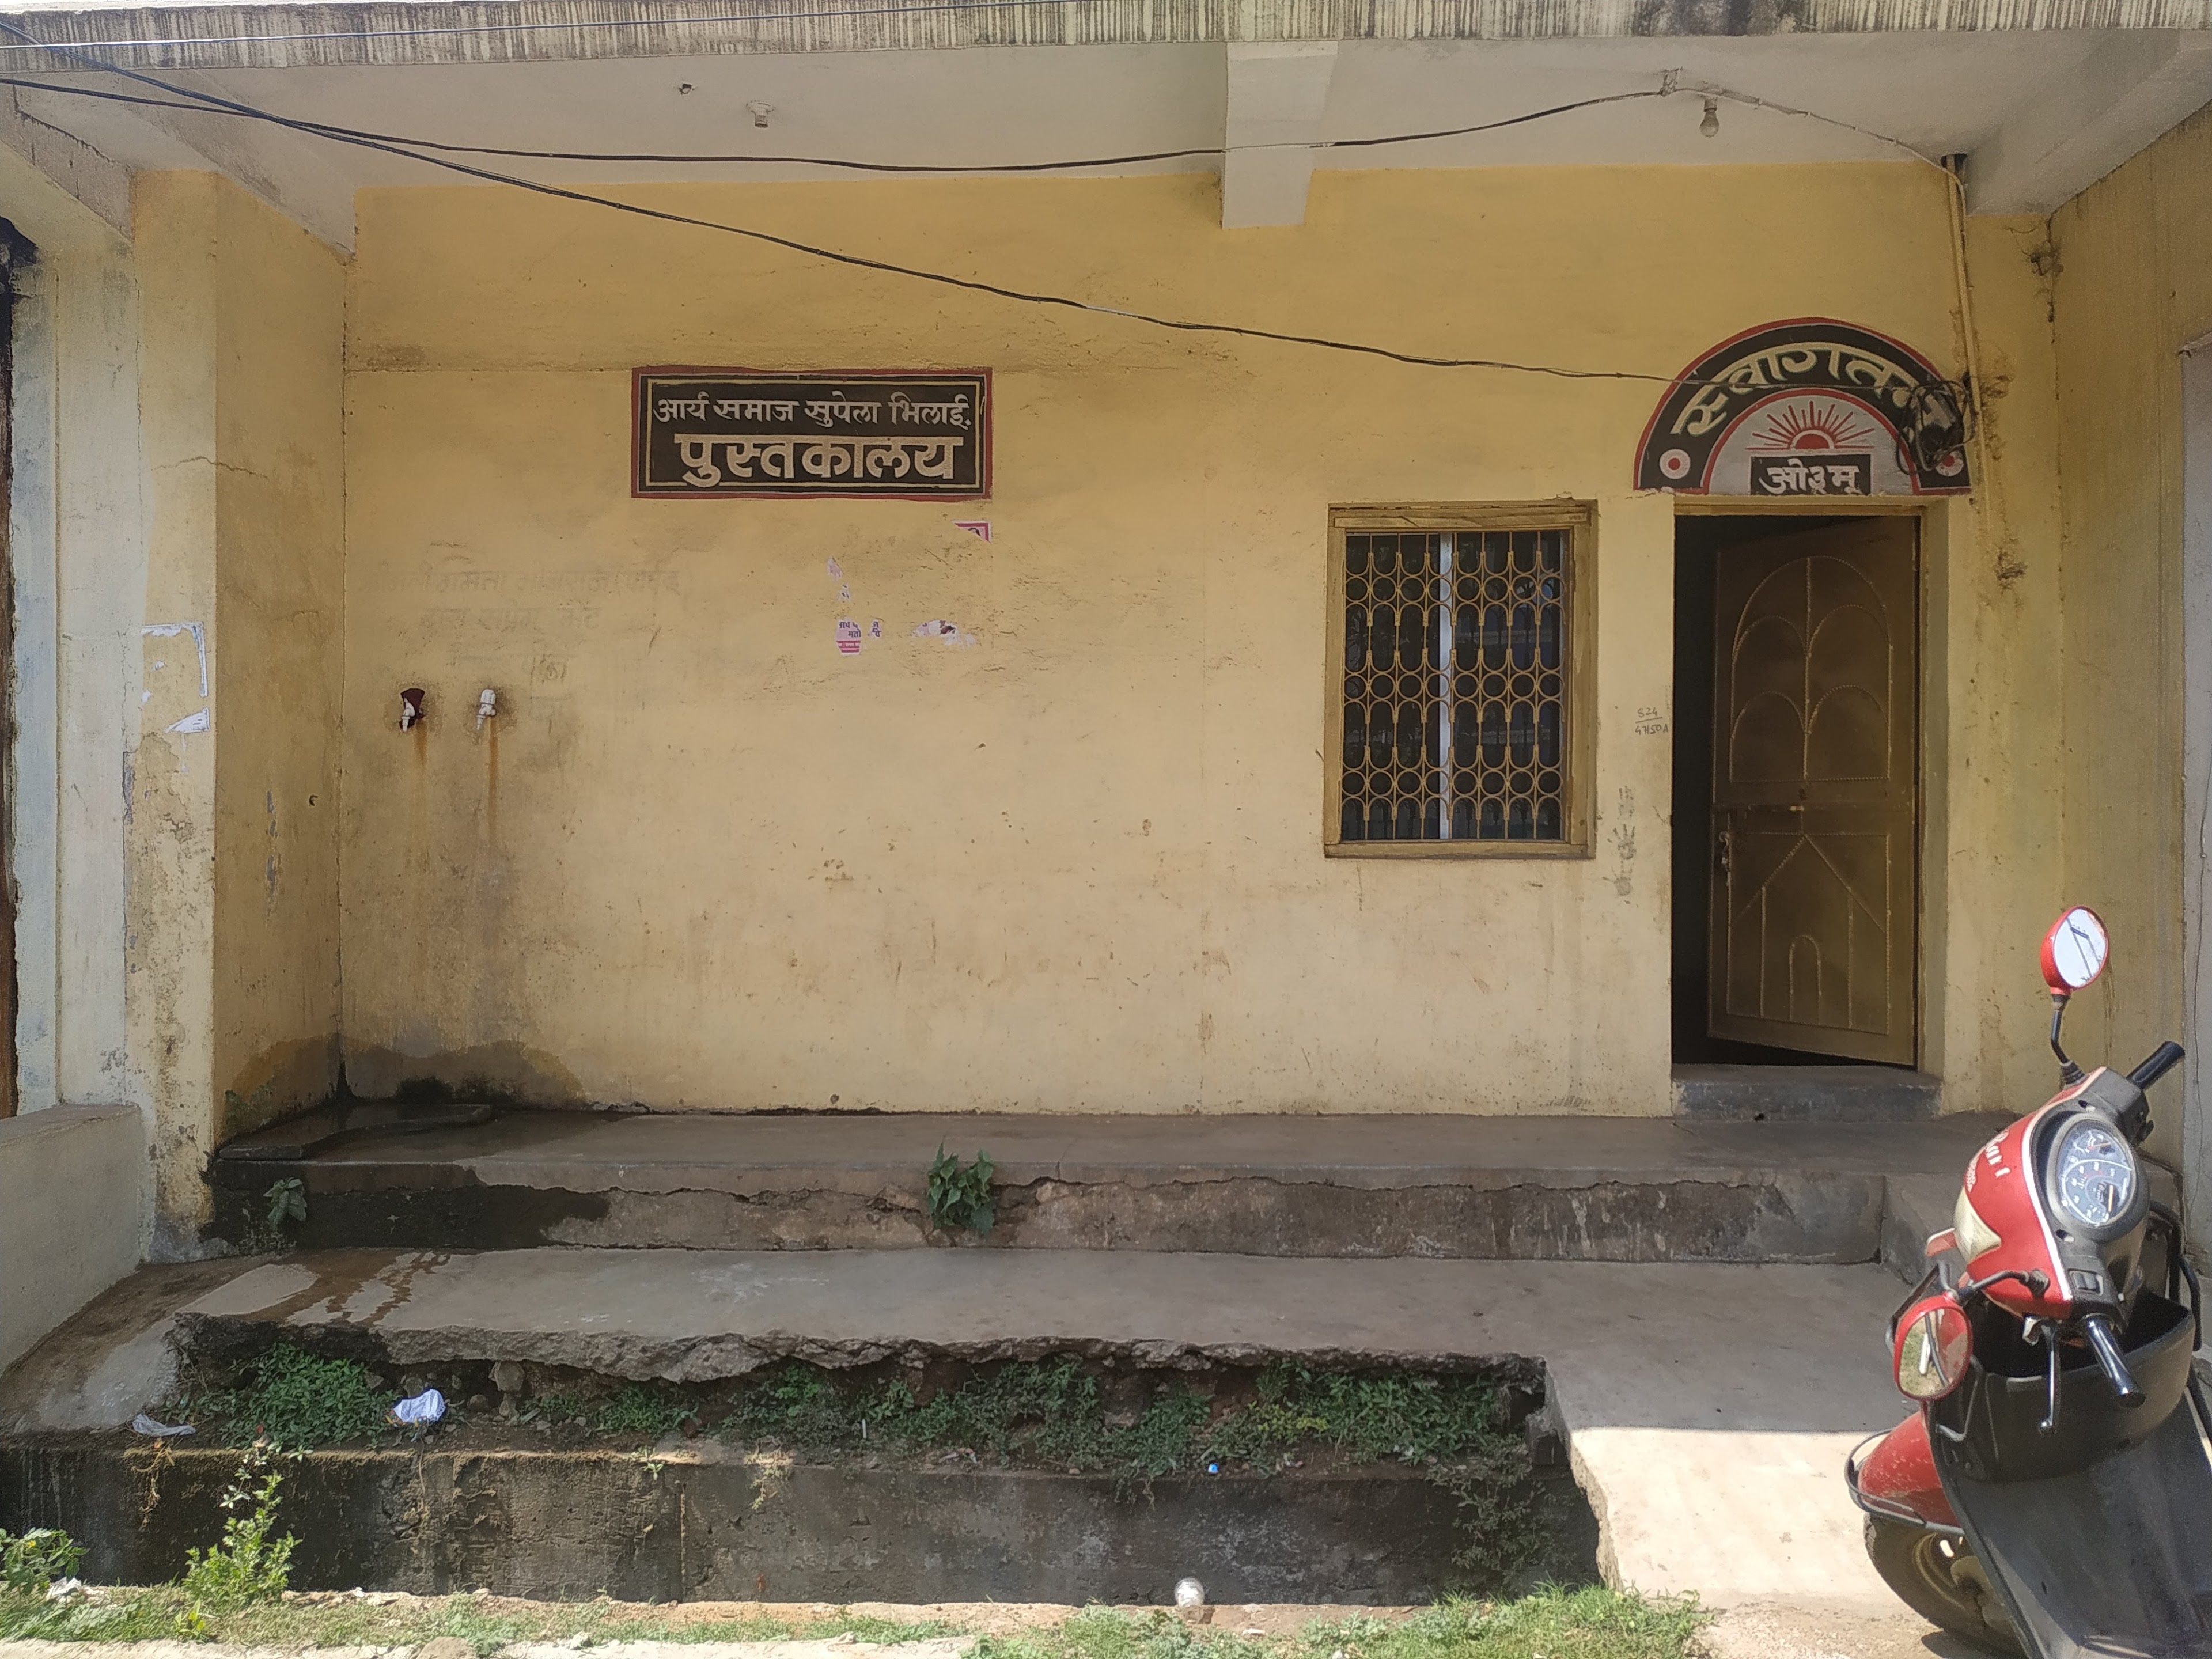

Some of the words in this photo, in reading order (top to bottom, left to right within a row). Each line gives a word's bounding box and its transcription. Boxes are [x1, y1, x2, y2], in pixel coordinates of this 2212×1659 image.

[653, 391, 710, 422] आर्य
[713, 399, 800, 422] समाज
[804, 391, 882, 428] सुपेला
[674, 433, 964, 488] पुस्तकालय
